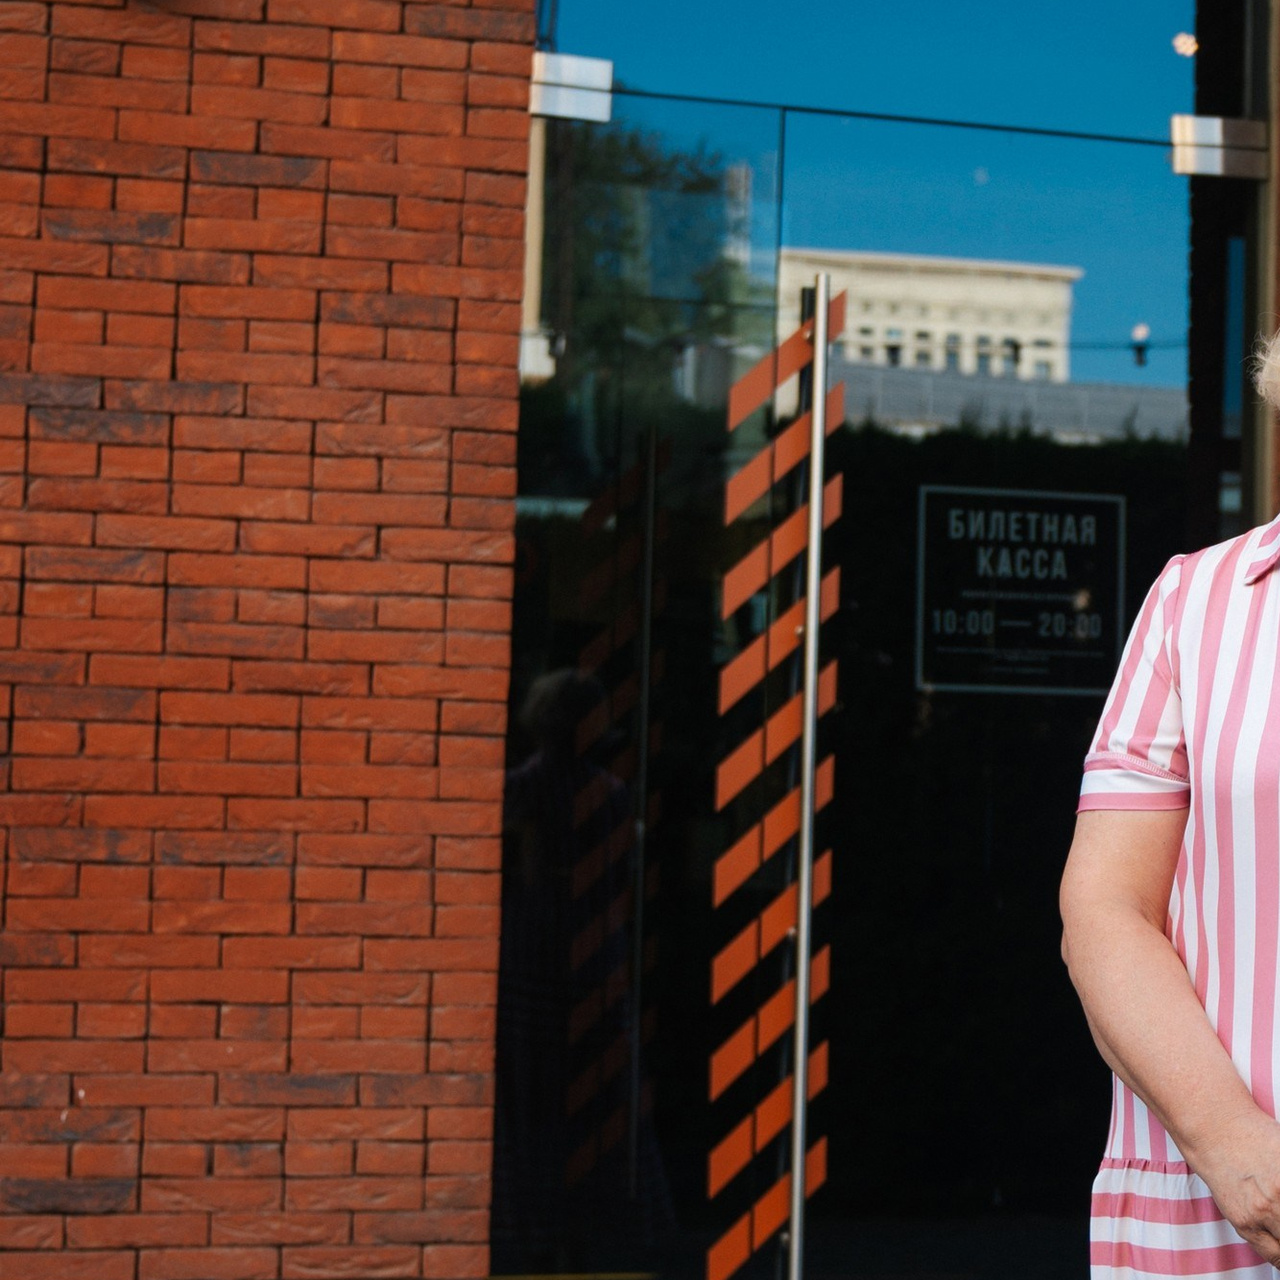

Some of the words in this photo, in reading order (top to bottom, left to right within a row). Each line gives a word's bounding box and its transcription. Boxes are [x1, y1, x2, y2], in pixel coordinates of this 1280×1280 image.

[948, 508, 1097, 545] БИЛЕТНАЯ
[977, 546, 1068, 580] КАССА
[932, 609, 995, 635] 10:00
[1037, 612, 1102, 638] 20:00
